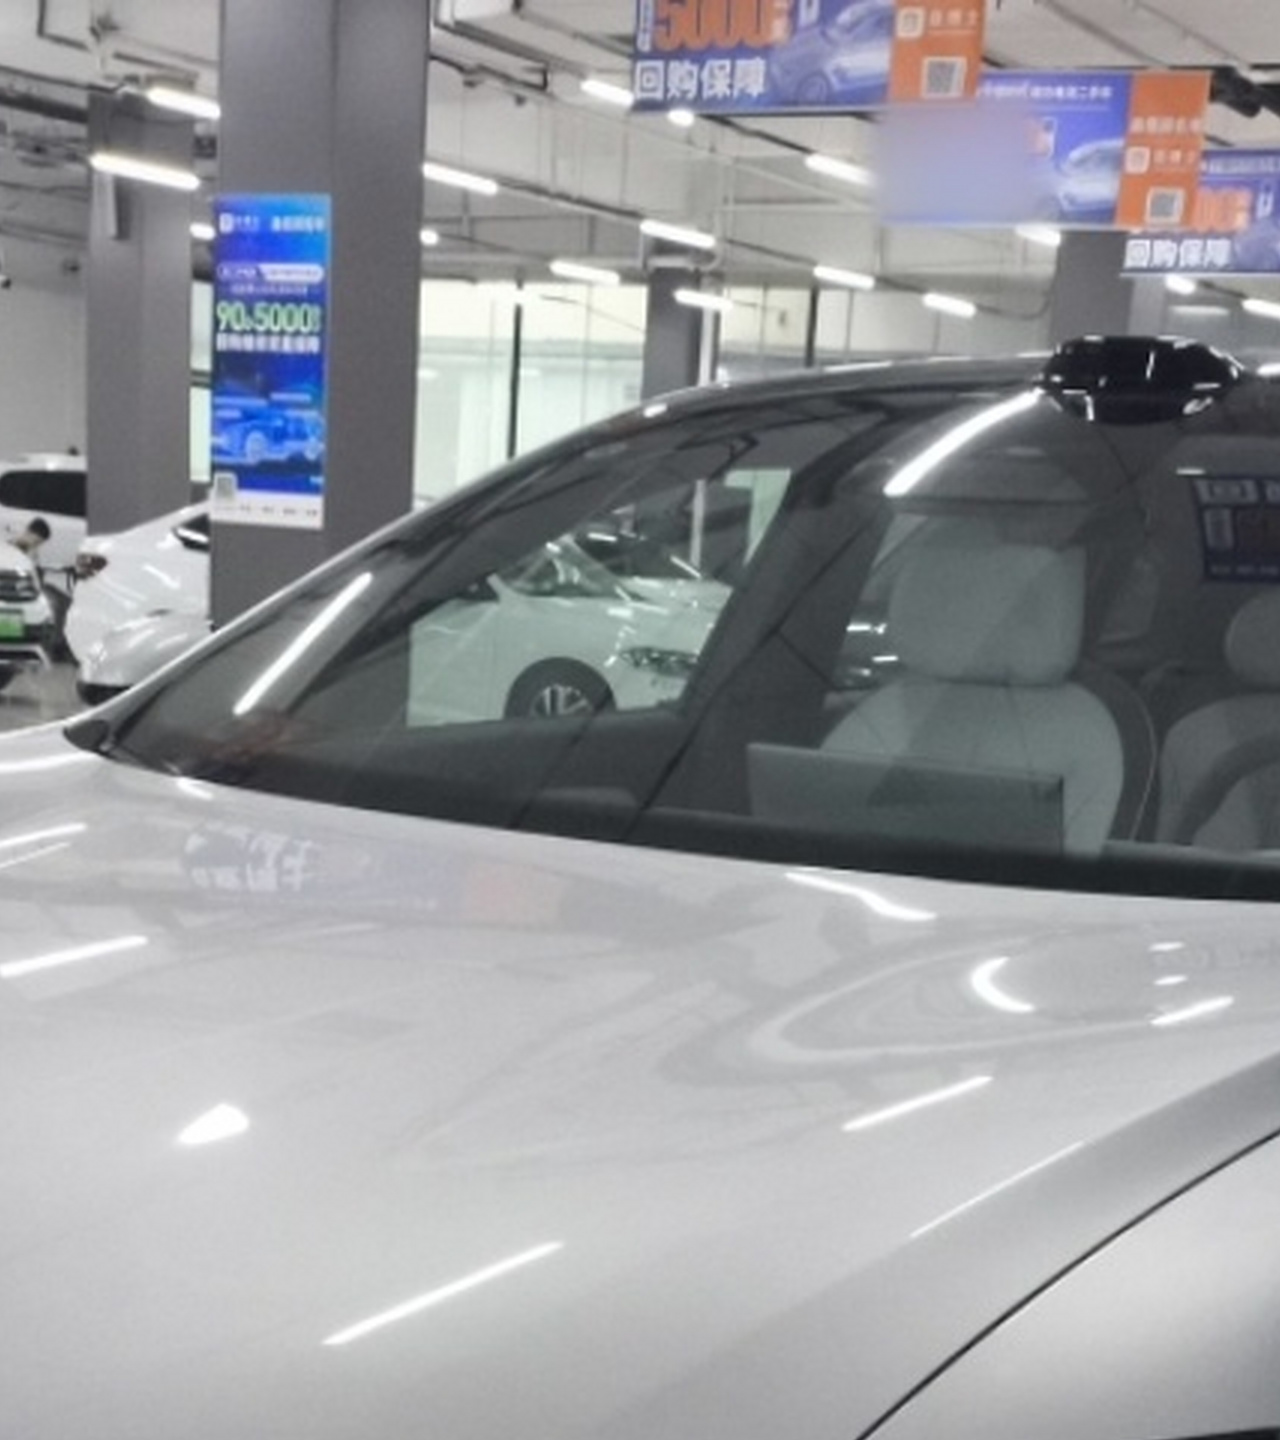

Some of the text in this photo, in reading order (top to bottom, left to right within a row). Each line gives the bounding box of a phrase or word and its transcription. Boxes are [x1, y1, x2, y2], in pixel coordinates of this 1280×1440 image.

[635, 57, 767, 99] 回购保障
[1124, 239, 1231, 268] 回购保障
